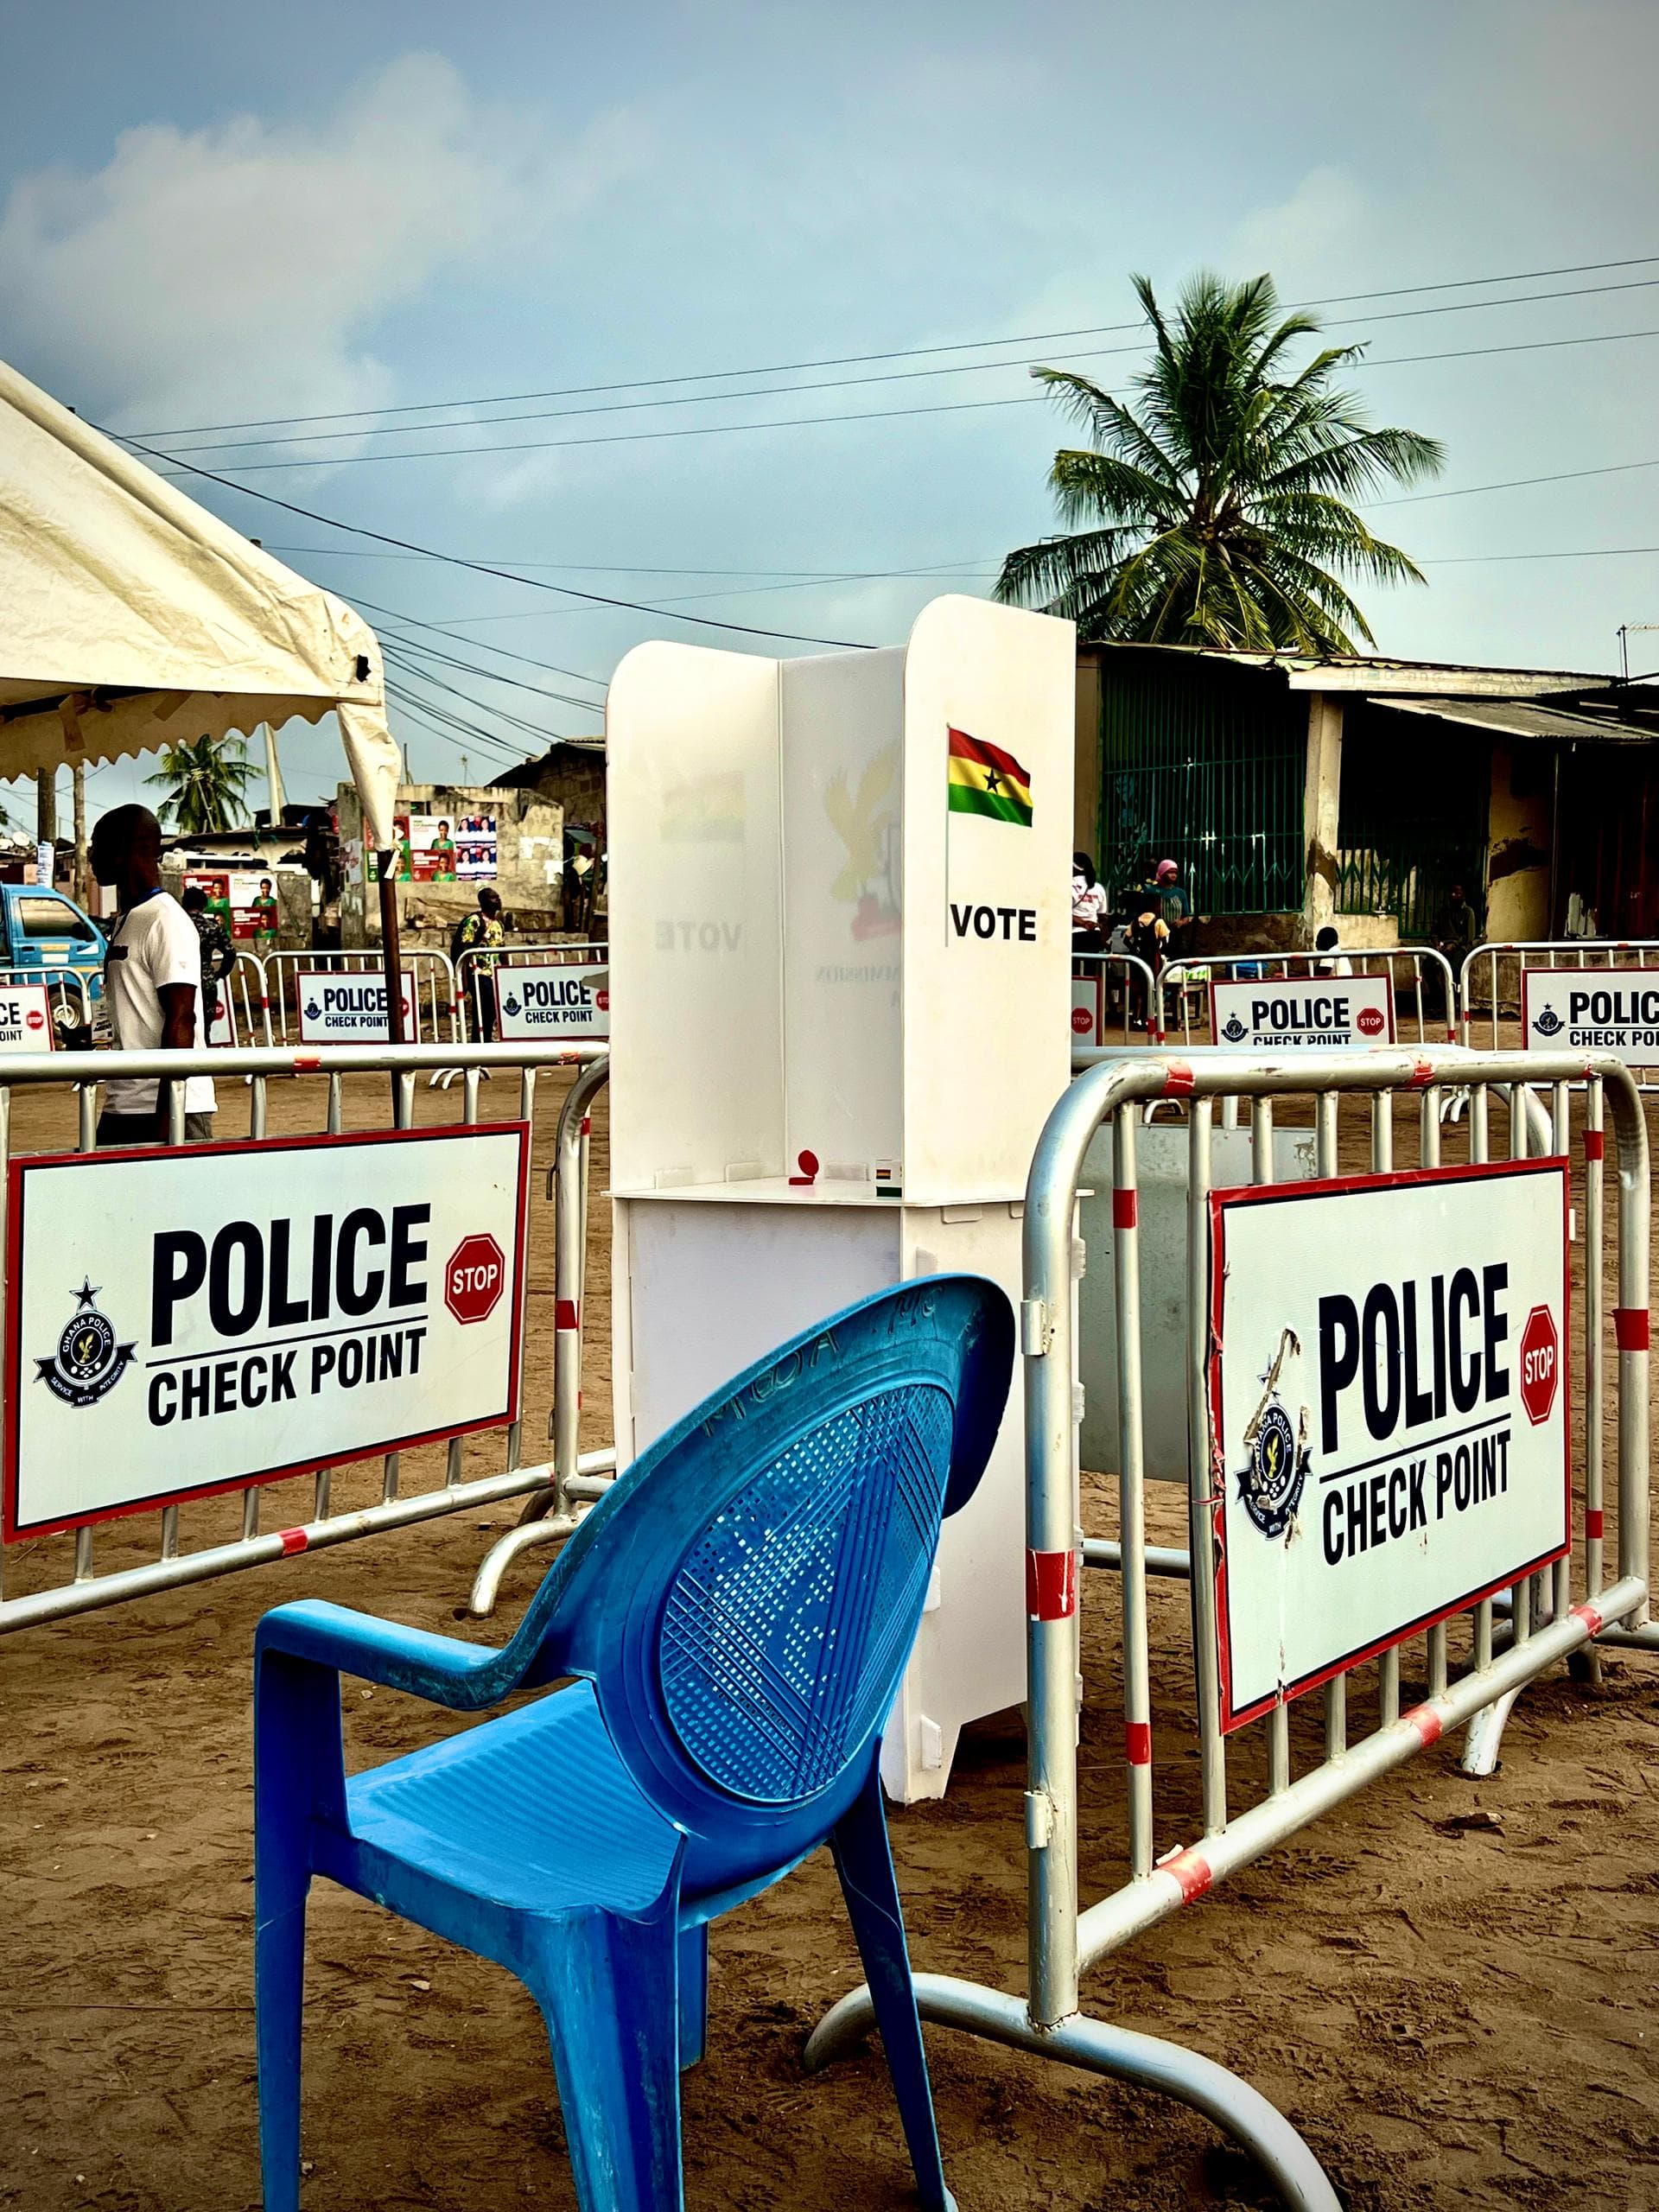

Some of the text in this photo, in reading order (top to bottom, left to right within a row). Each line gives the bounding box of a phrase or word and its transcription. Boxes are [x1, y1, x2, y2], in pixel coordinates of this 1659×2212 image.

[950, 904, 1036, 941] VOTE
[324, 988, 388, 1012] POLICE
[523, 981, 591, 1007] POLICE
[1570, 991, 1659, 1025] POLIC
[325, 1016, 389, 1027] CHECK POINT
[525, 1011, 593, 1023] CHECK POINT
[1072, 1016, 1090, 1025] STOP
[1252, 998, 1350, 1030] POLICE
[1360, 1018, 1382, 1027] STOP
[0, 1030, 22, 1042] OINT
[1253, 1034, 1351, 1046] CHECK POINT
[1570, 1031, 1659, 1046] CHECK POI
[151, 1203, 430, 1346] POLICE
[453, 1263, 498, 1296] STOP
[62, 1317, 111, 1353] GHANA POLICE
[1319, 1262, 1509, 1454] POLICE
[1524, 1345, 1554, 1385] STOP
[50, 1361, 124, 1403] SERVICE WITH INTEGRITY
[148, 1328, 427, 1427] CHECK POINT
[1273, 1412, 1292, 1453] POLICE
[1322, 1430, 1511, 1566] CHECK POINT
